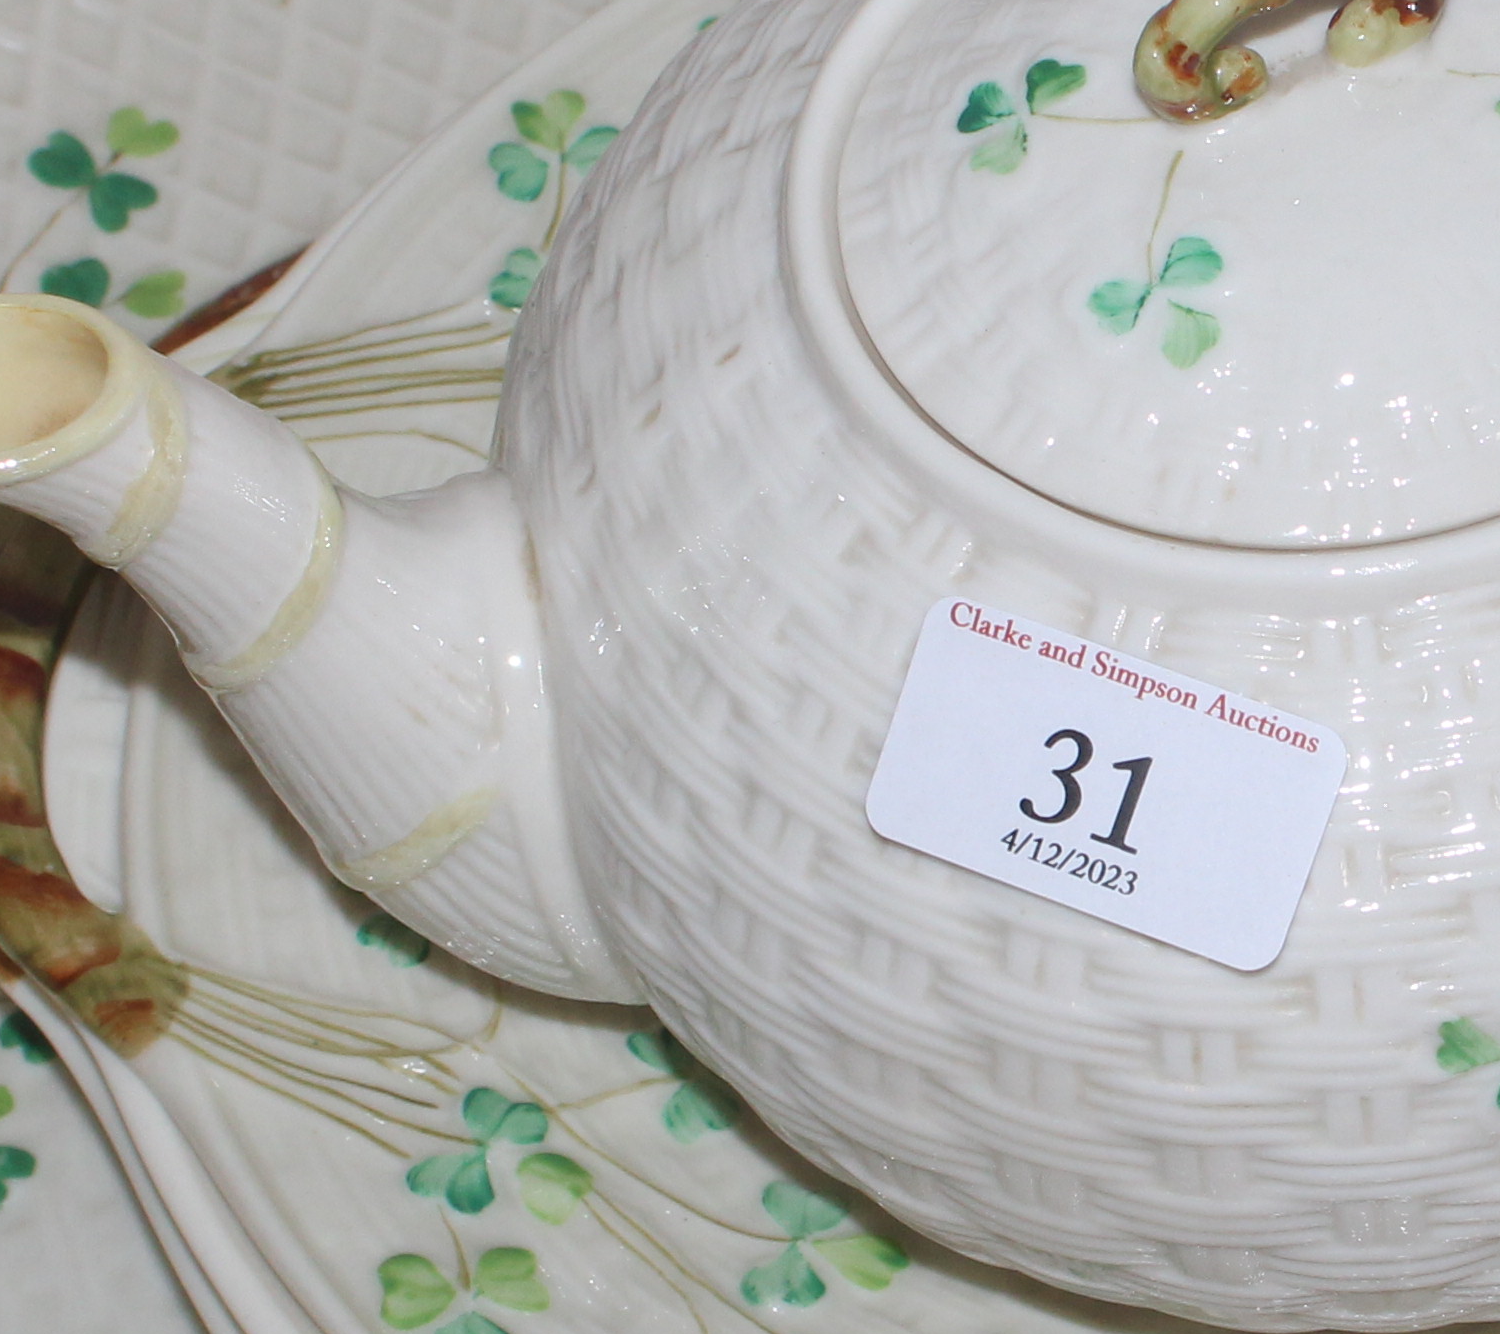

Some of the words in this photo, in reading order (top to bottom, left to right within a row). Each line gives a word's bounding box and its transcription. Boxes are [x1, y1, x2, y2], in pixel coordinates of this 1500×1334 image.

[949, 601, 1032, 651] Clarke
[1037, 636, 1087, 669] and
[1091, 651, 1199, 710] Simpson
[1203, 693, 1321, 754] Auctions
[1018, 728, 1153, 855] 31
[1000, 828, 1139, 896] 4/12/2023
